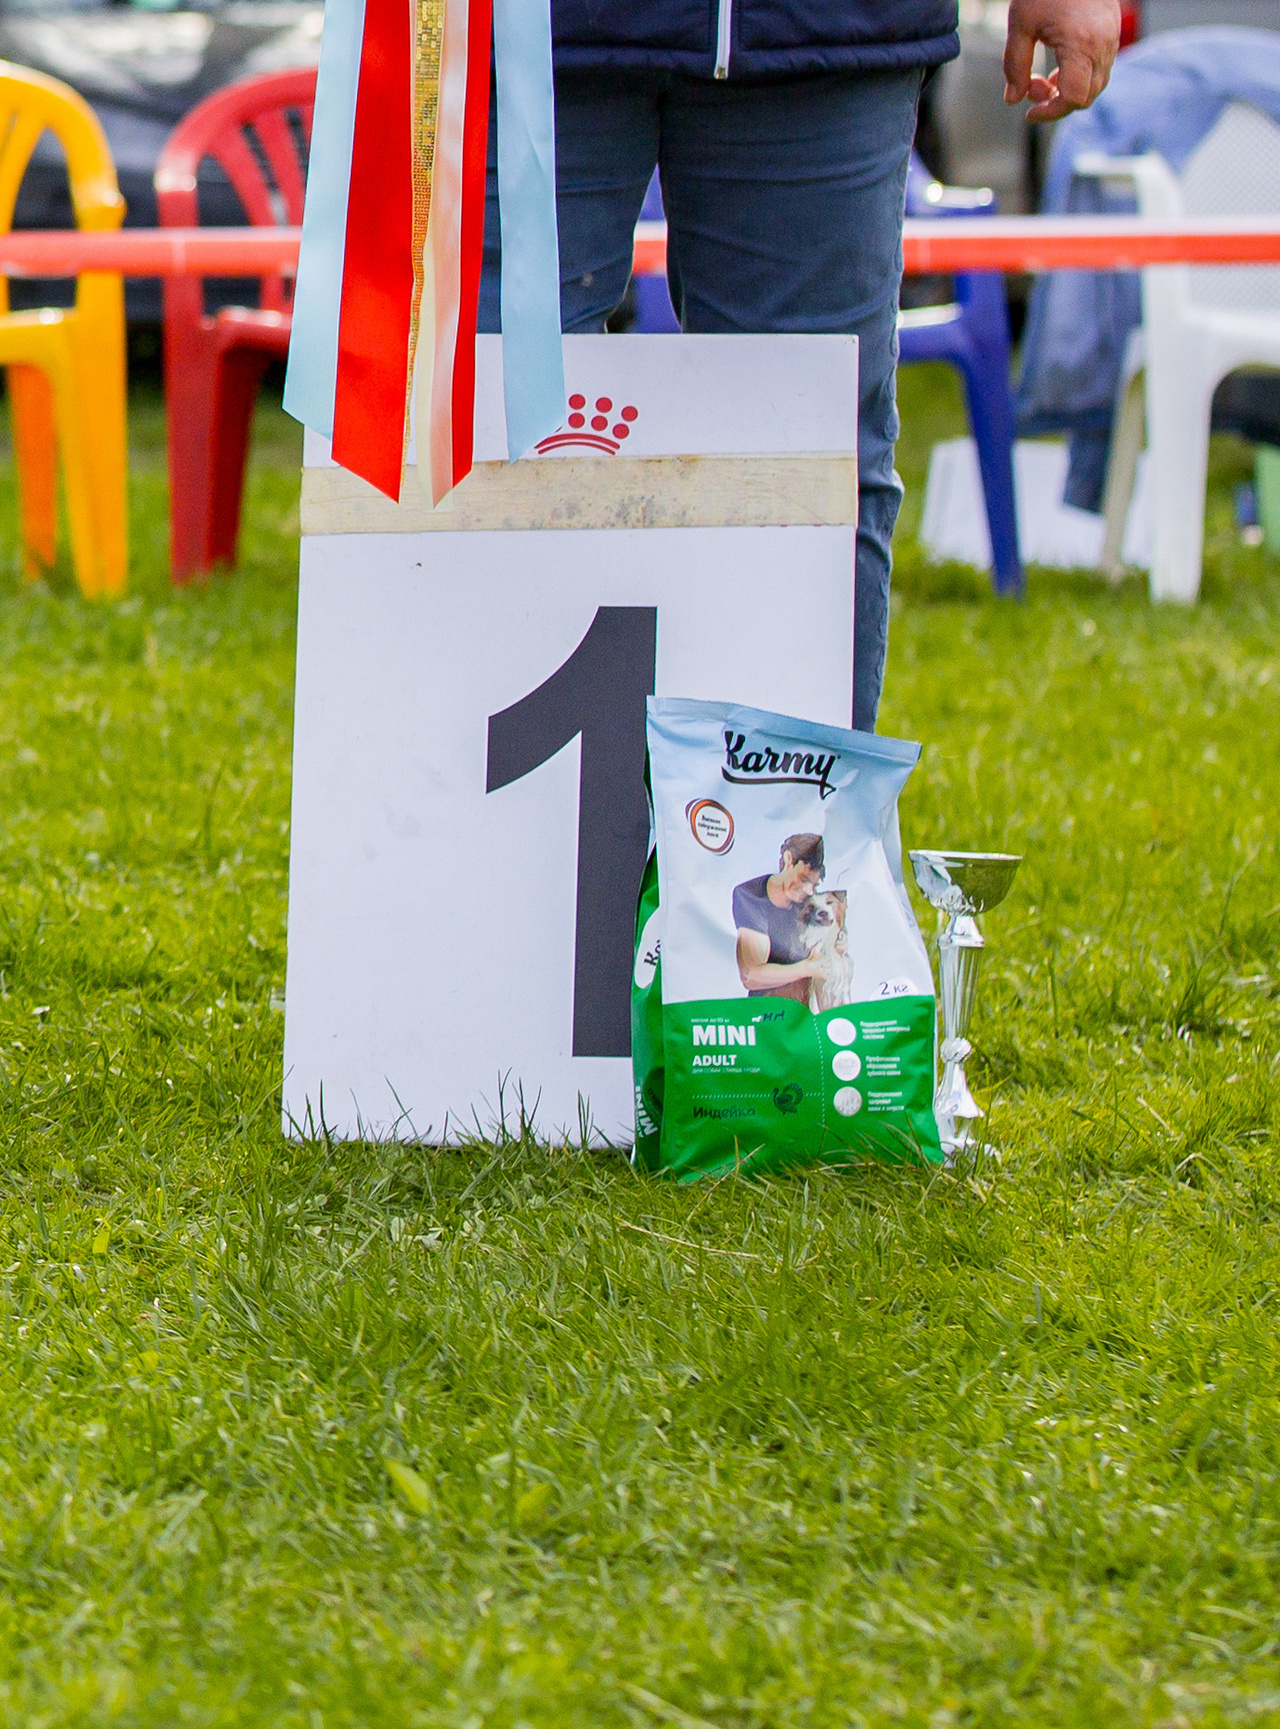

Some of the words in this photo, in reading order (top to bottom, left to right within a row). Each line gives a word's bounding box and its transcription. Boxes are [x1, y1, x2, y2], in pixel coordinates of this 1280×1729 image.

[721, 730, 838, 801] Karmy
[486, 606, 657, 1058] 1
[880, 982, 890, 995] 2
[692, 1024, 756, 1046] MINI
[692, 1054, 737, 1067] ADULT
[693, 1105, 756, 1120] Индейка
